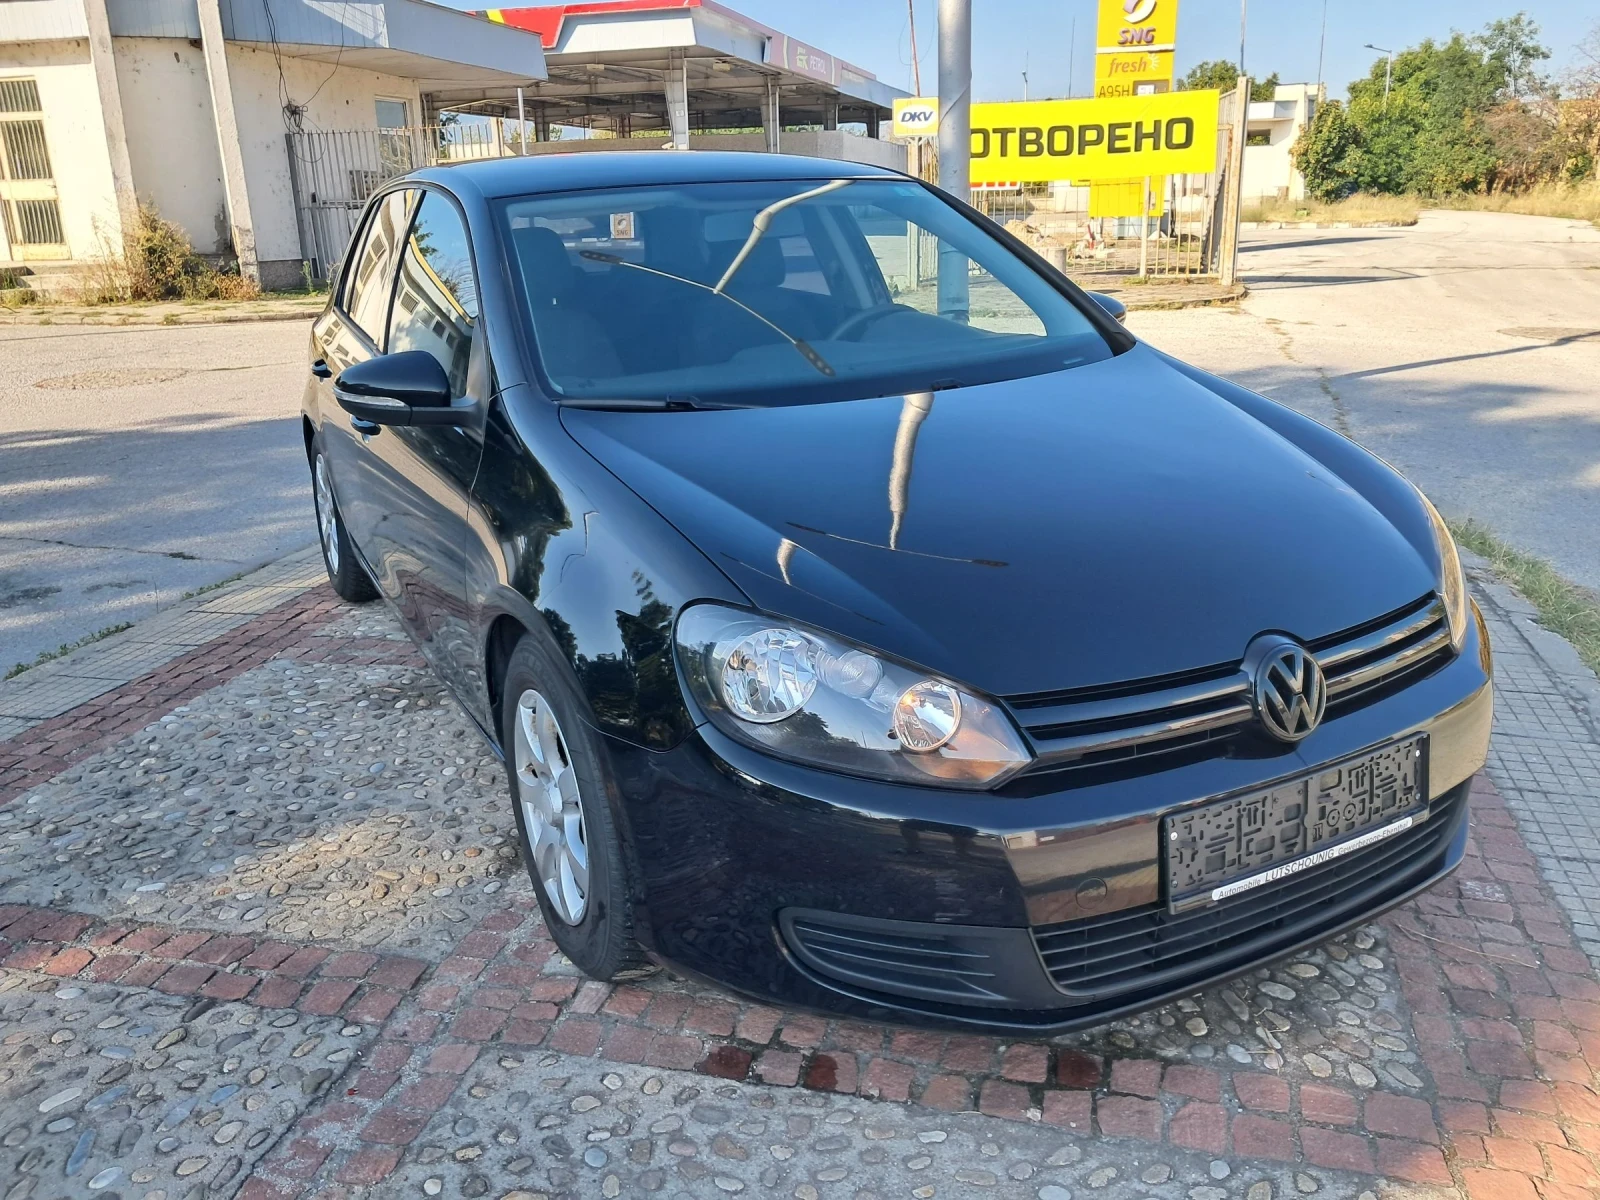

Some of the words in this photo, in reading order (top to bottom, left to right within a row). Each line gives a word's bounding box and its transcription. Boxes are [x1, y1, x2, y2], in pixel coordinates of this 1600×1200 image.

[1117, 27, 1156, 45] SNG
[810, 55, 827, 75] PETROL
[1108, 57, 1148, 78] fresh
[901, 111, 934, 122] DKV
[970, 116, 1194, 158] ОТВОРЕНО
[1219, 878, 1261, 899] Automobile
[1265, 848, 1335, 882] LUTSCHOUNIG
